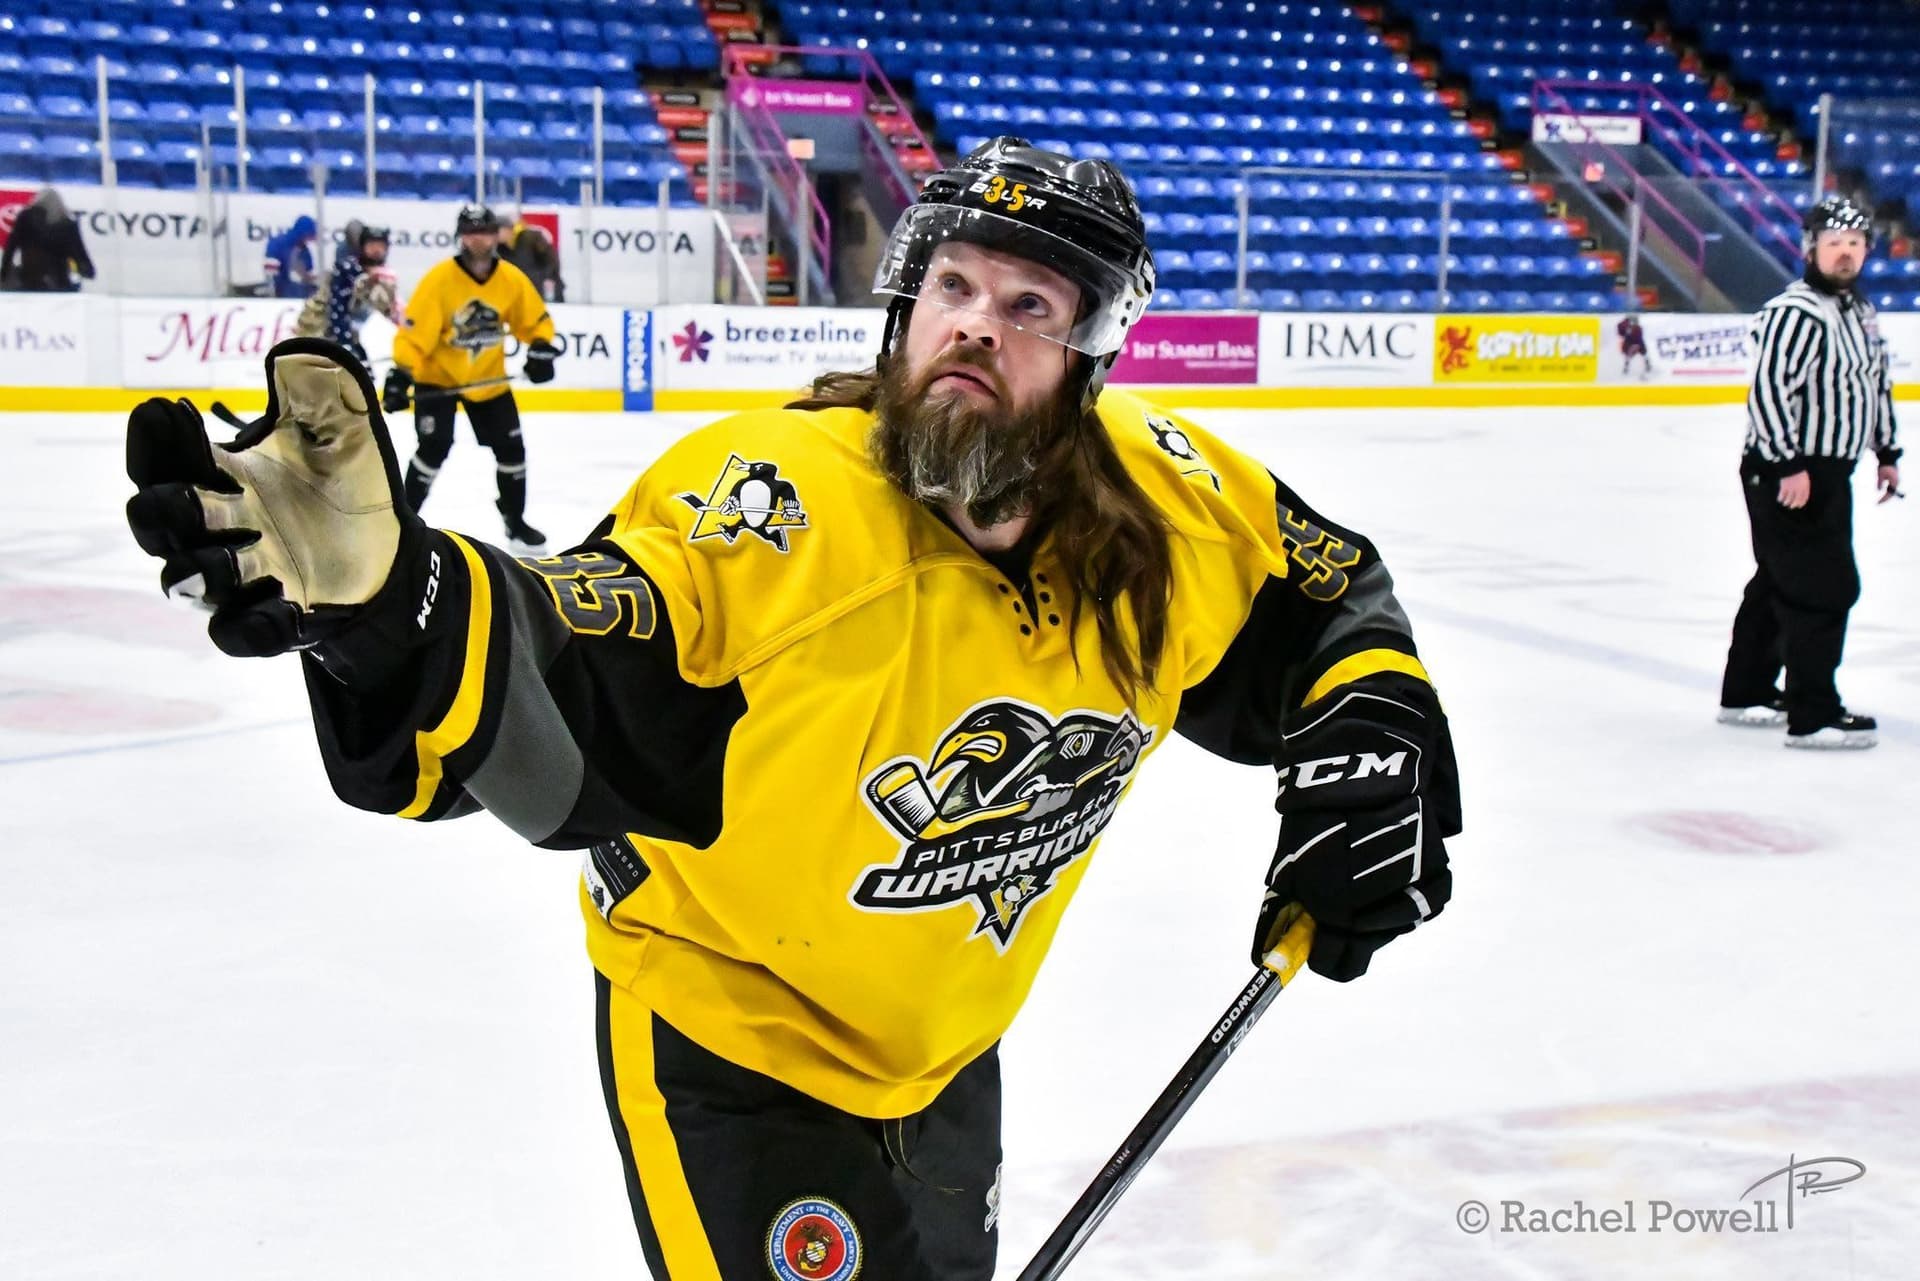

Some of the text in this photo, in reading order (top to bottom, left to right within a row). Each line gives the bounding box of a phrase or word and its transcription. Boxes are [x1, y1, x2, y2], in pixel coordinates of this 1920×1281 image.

[984, 175, 1028, 211] 35
[573, 229, 694, 254] TOYOTA
[16, 327, 76, 351] PLAN
[725, 319, 867, 343] breezeline
[1284, 322, 1418, 359] IRMC
[418, 550, 440, 631] CCM
[913, 788, 1112, 869] PITTSBURGH
[872, 800, 1117, 898] WARRIORS
[1211, 968, 1273, 1044] HERWOOD
